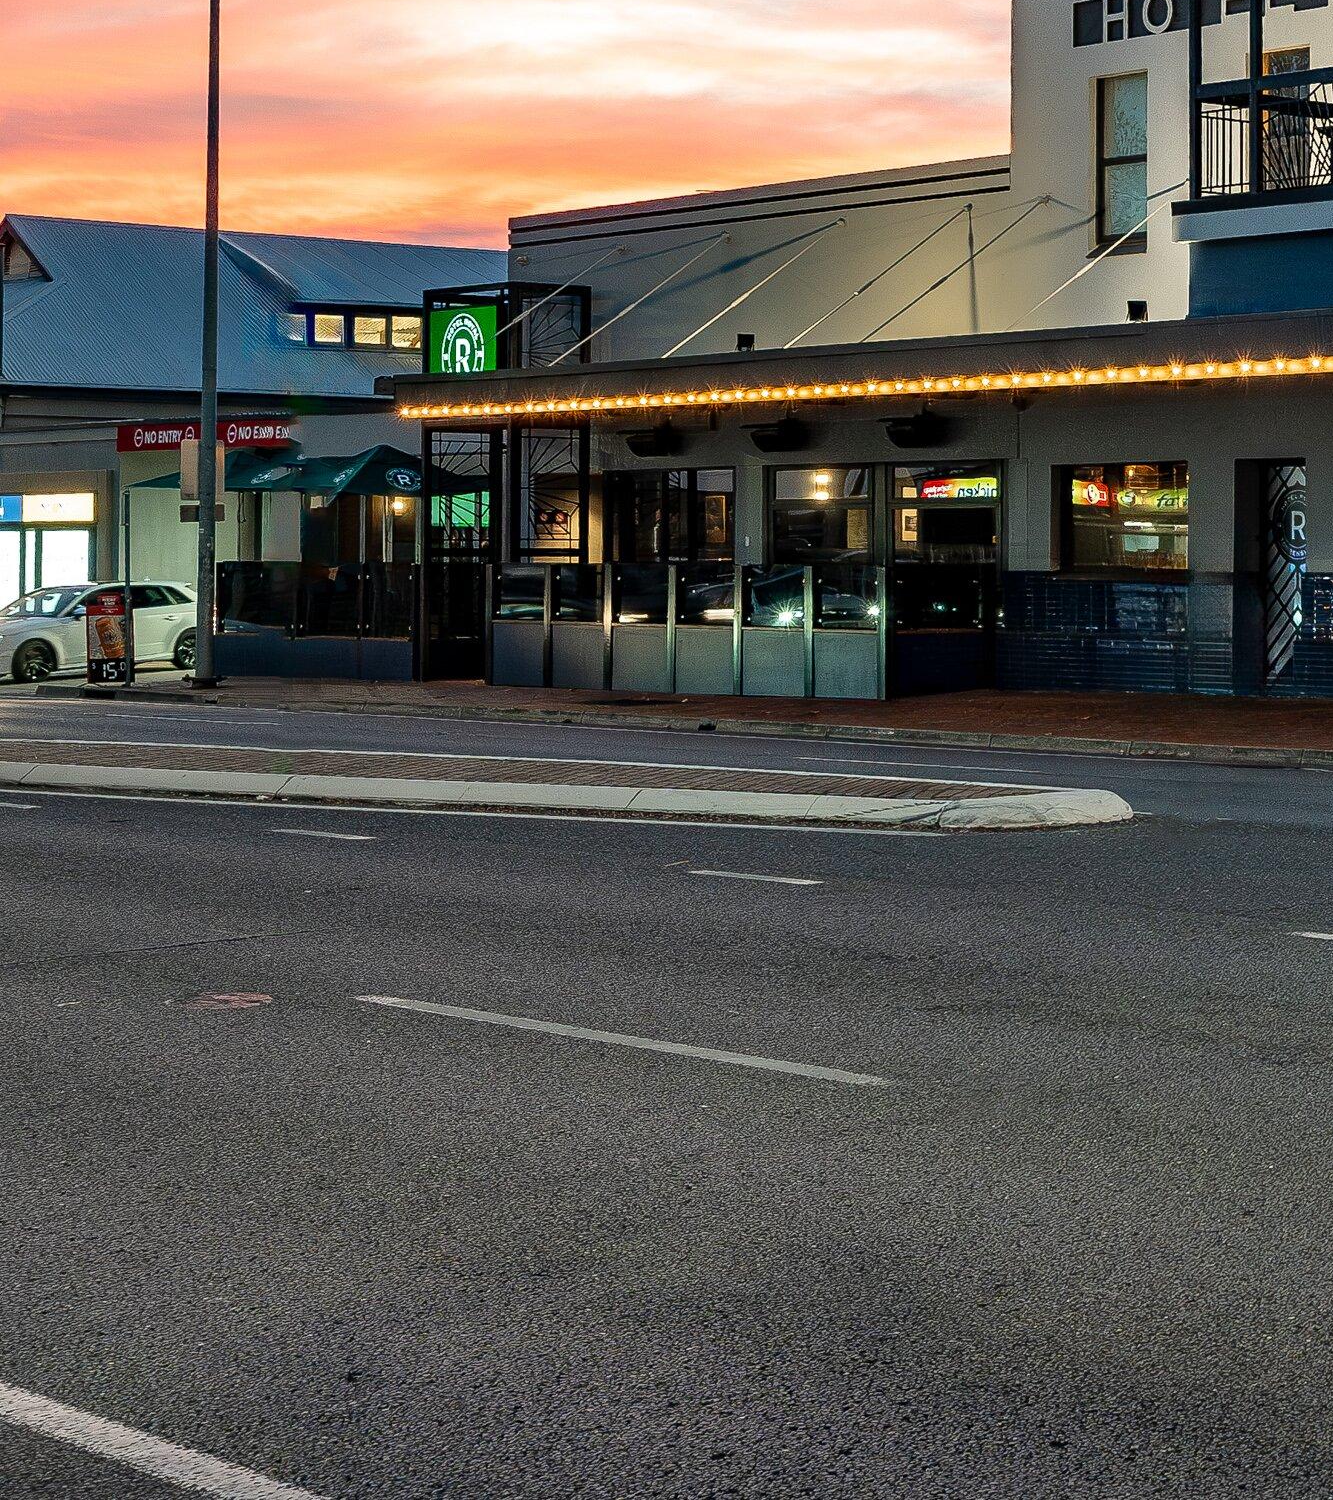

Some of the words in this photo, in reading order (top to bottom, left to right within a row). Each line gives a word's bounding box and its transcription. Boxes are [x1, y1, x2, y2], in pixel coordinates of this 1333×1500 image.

[456, 338, 470, 372] R
[144, 431, 157, 444] NO
[159, 430, 182, 443] ENTRY
[239, 427, 251, 439] NO
[397, 474, 411, 485] R
[1291, 510, 1306, 540] R
